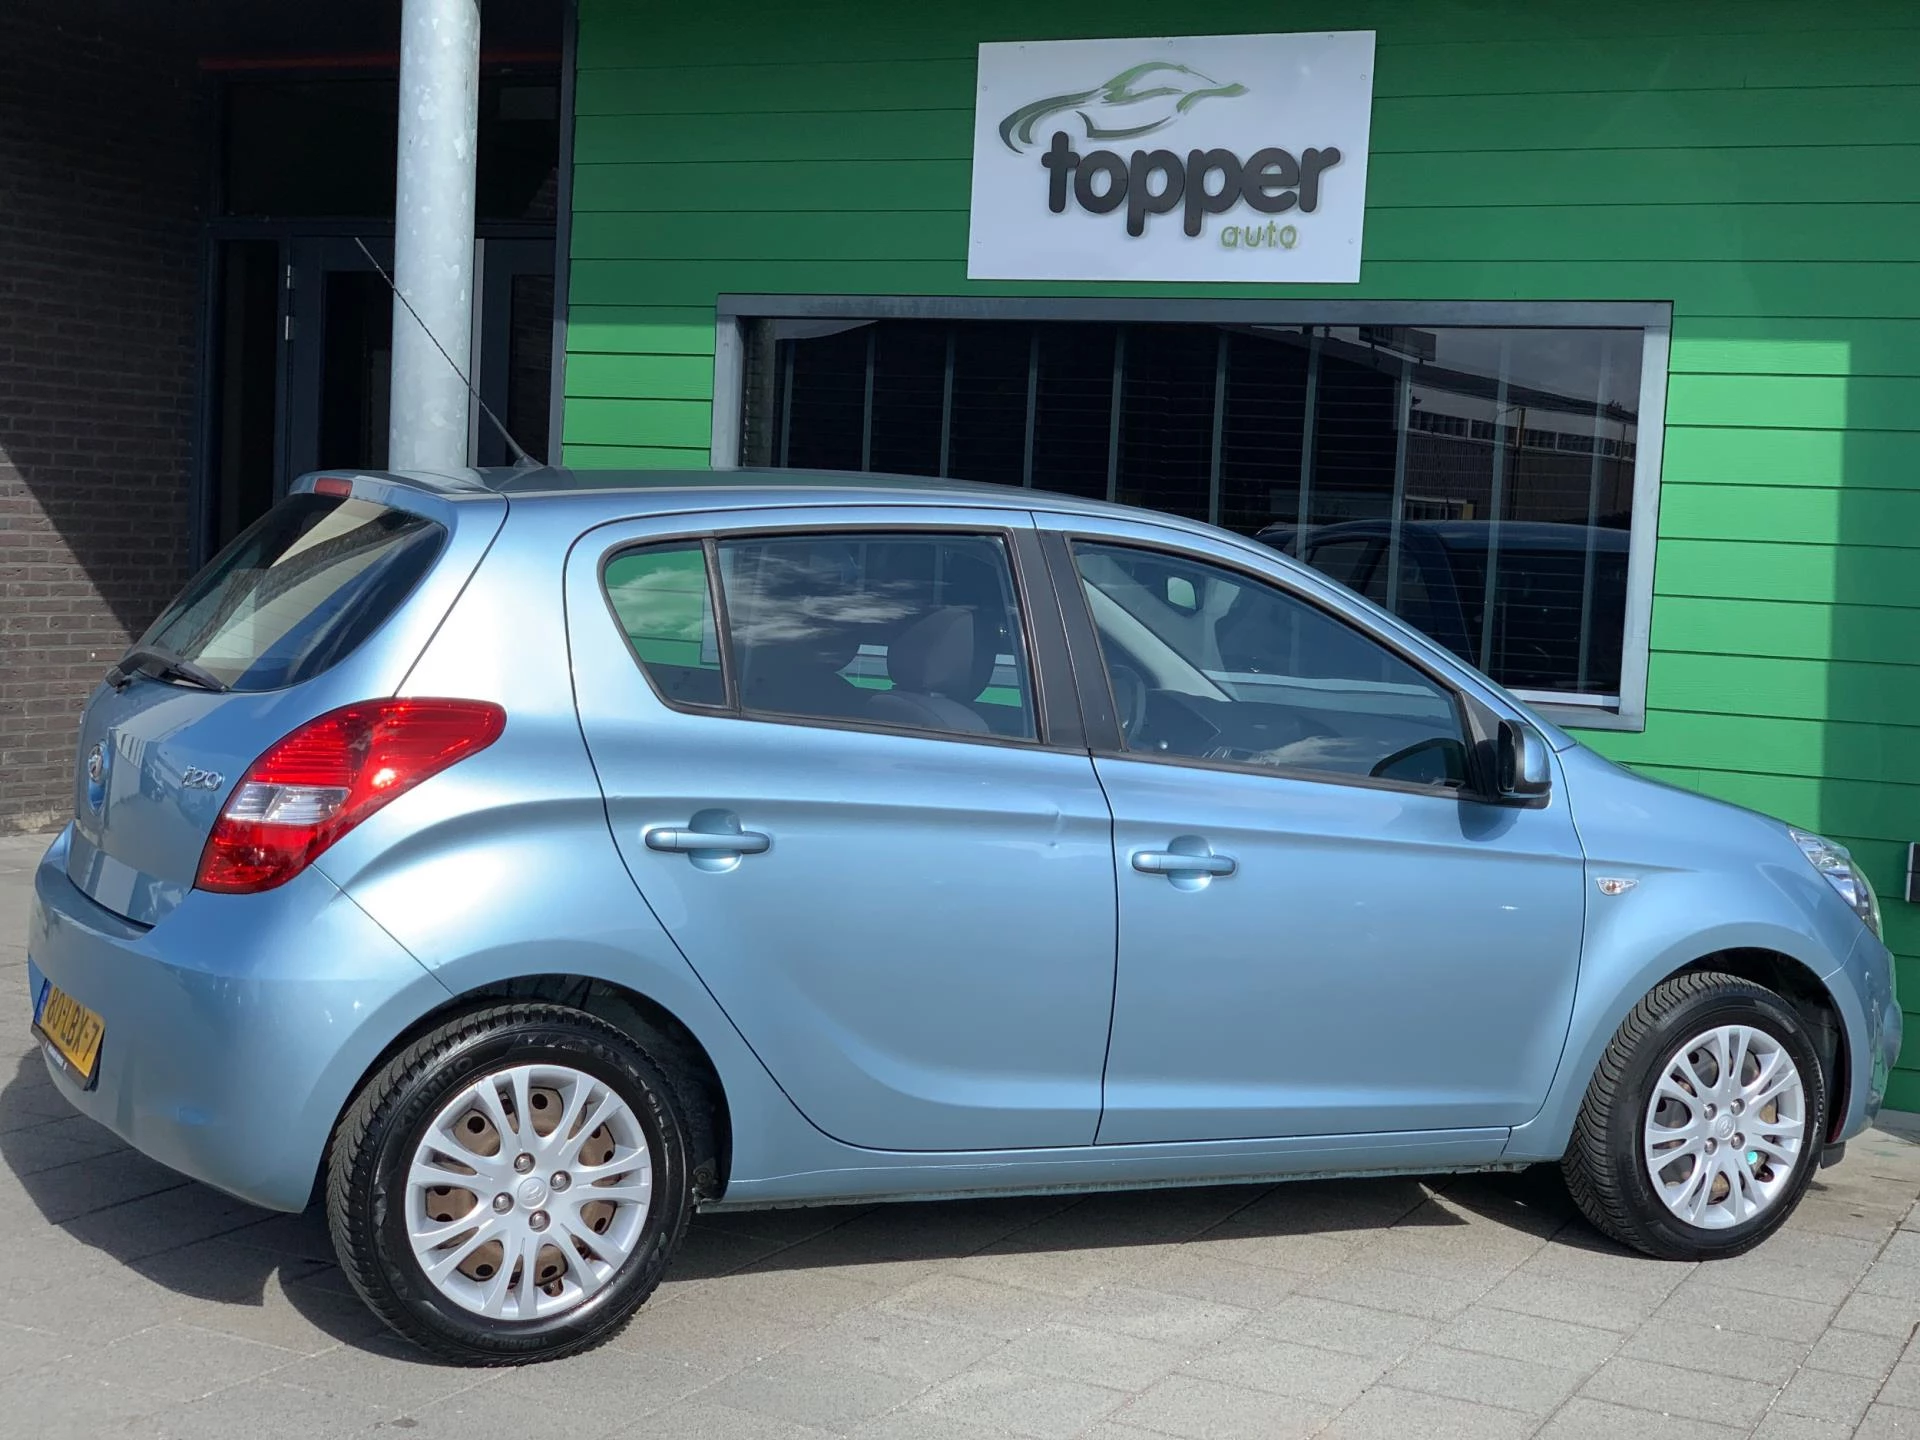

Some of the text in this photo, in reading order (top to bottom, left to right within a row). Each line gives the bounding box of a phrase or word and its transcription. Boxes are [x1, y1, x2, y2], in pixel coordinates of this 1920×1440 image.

[1041, 130, 1341, 237] topper
[1220, 220, 1298, 249] auto
[182, 765, 225, 791] i20
[399, 1056, 473, 1127] KUMHO
